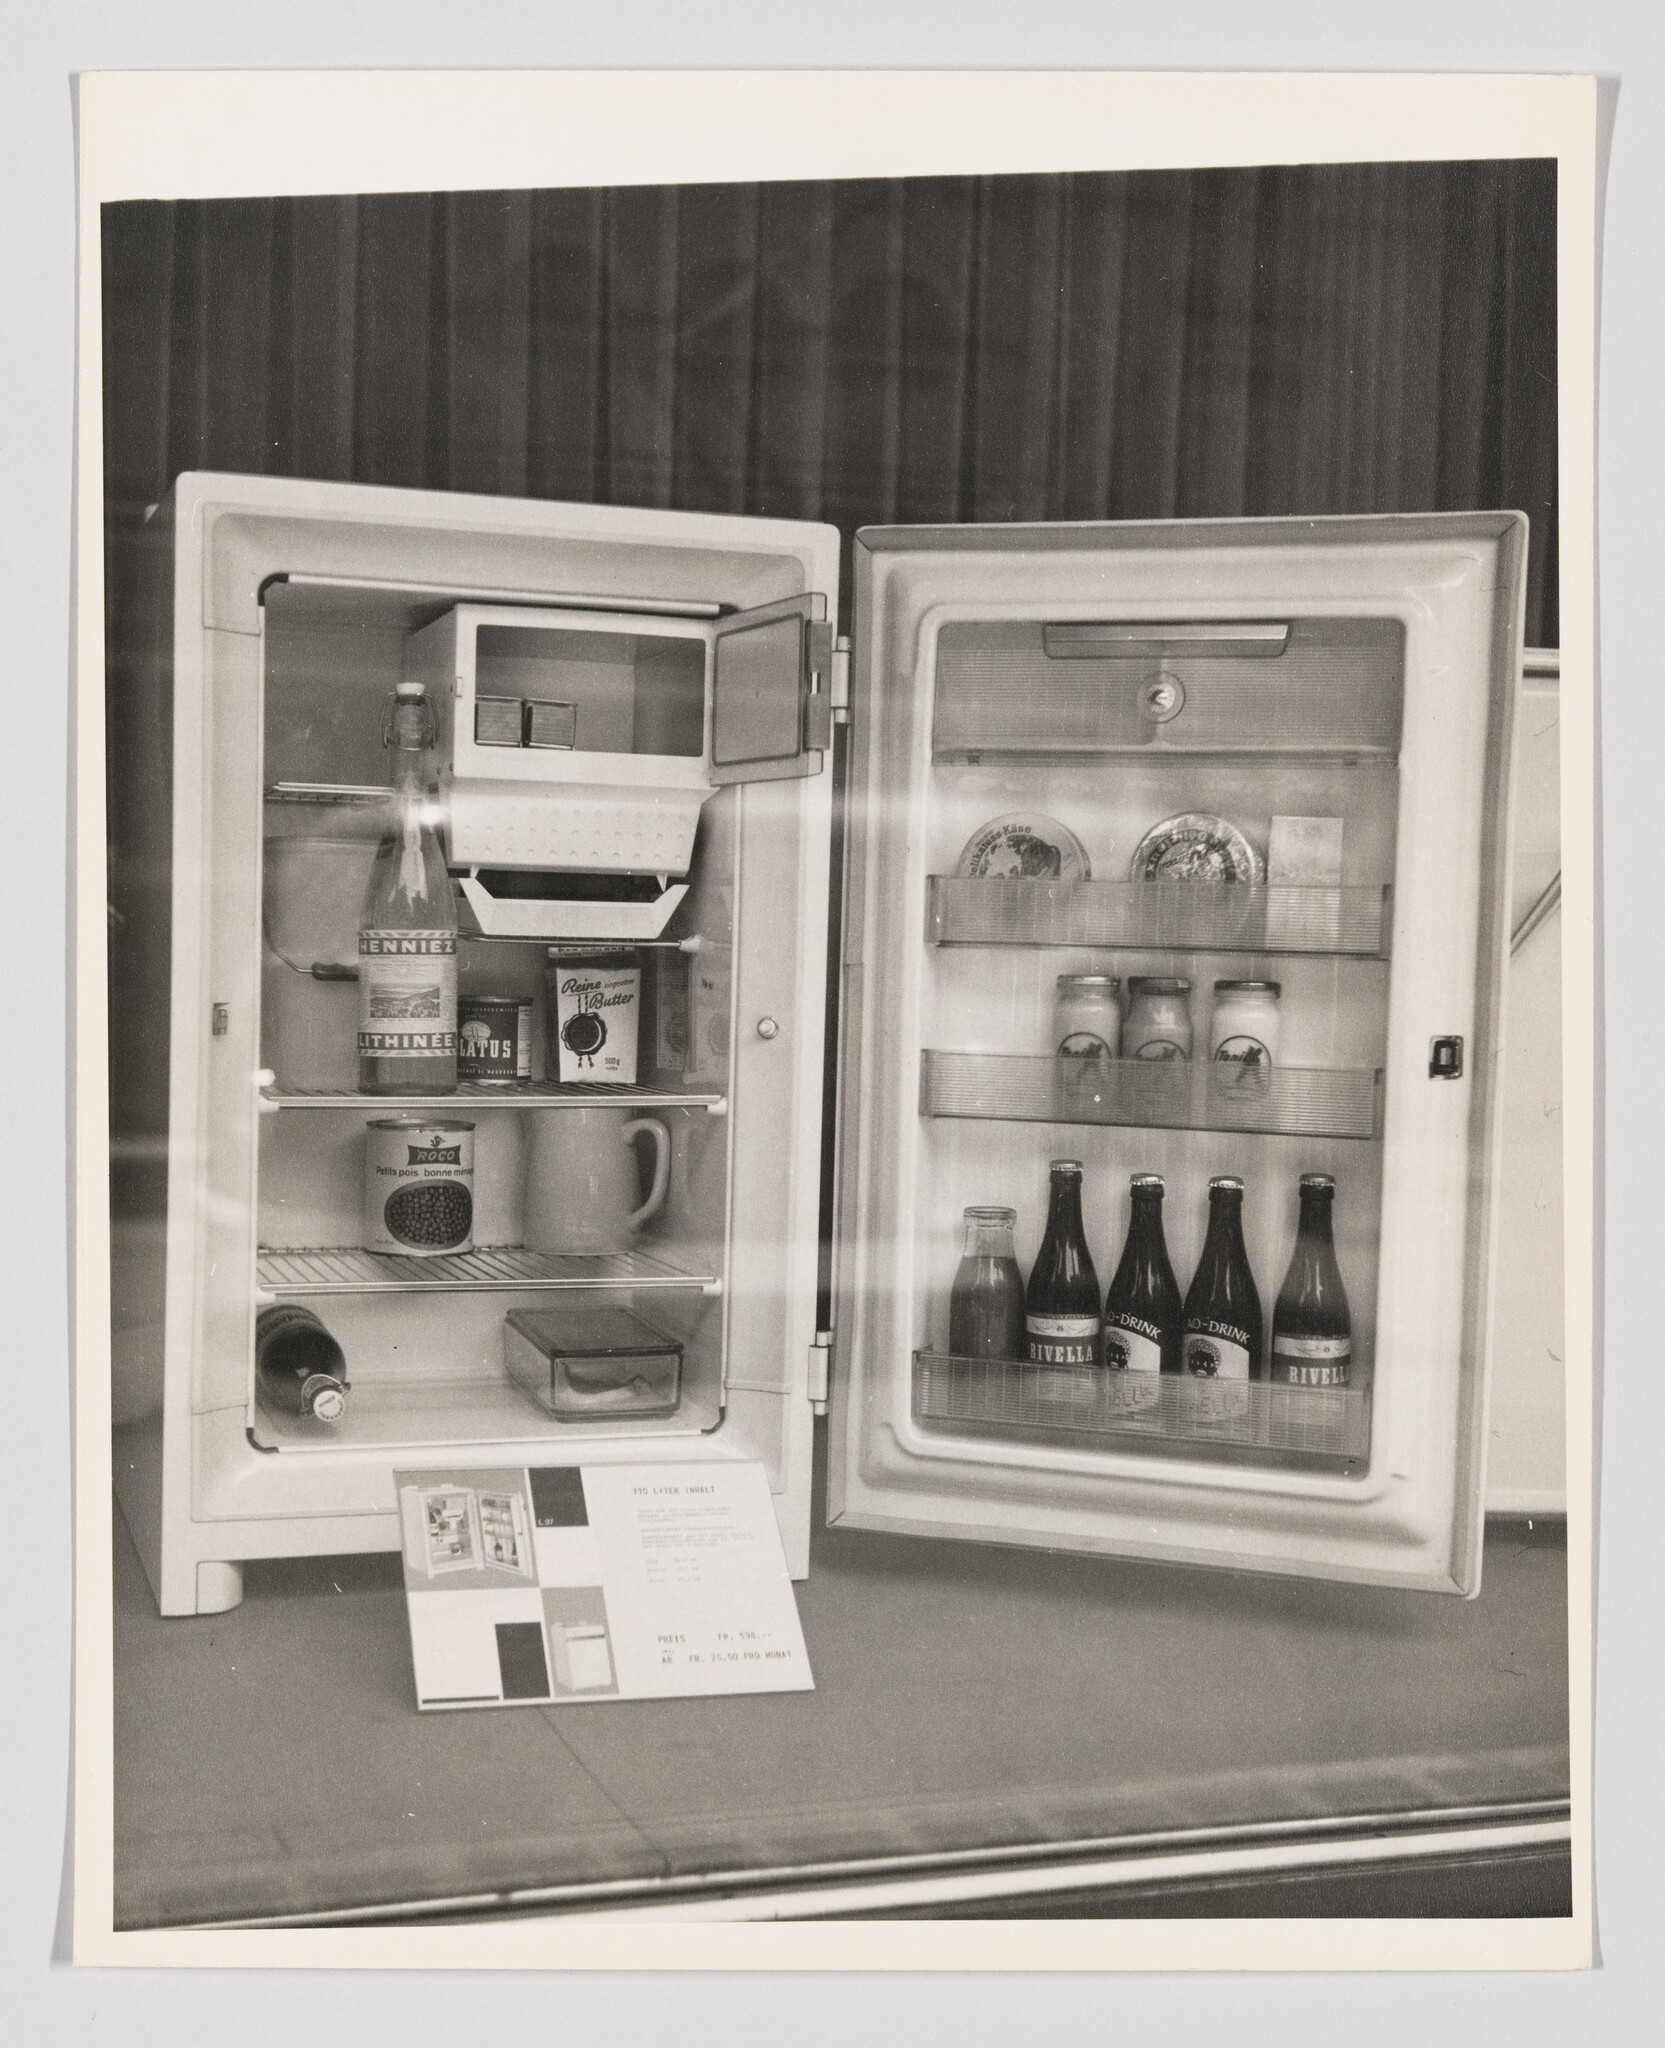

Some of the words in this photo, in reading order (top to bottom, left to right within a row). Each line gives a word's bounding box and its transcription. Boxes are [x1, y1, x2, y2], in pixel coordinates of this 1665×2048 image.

[360, 941, 453, 954] HENNIEZ
[560, 978, 601, 994] Reine
[588, 992, 633, 1009] Butter
[358, 1033, 453, 1049] LITHINÉE
[459, 1038, 511, 1058] LATUS
[416, 1150, 455, 1161] ROCO
[376, 1166, 397, 1176] Petits
[398, 1168, 418, 1178] pois
[423, 1168, 452, 1177] bonne
[453, 1167, 474, 1177] ménag
[1107, 1311, 1162, 1340] O-DRINK
[1186, 1317, 1251, 1345] AO-DRINK
[1029, 1343, 1094, 1363] RIVELLA
[1288, 1365, 1351, 1385] RIVELL
[653, 1486, 679, 1495] LITER
[685, 1485, 715, 1494] INHALT
[656, 1634, 686, 1644] PREIS
[742, 1651, 760, 1661] PRO
[764, 1649, 792, 1660] MONAT
